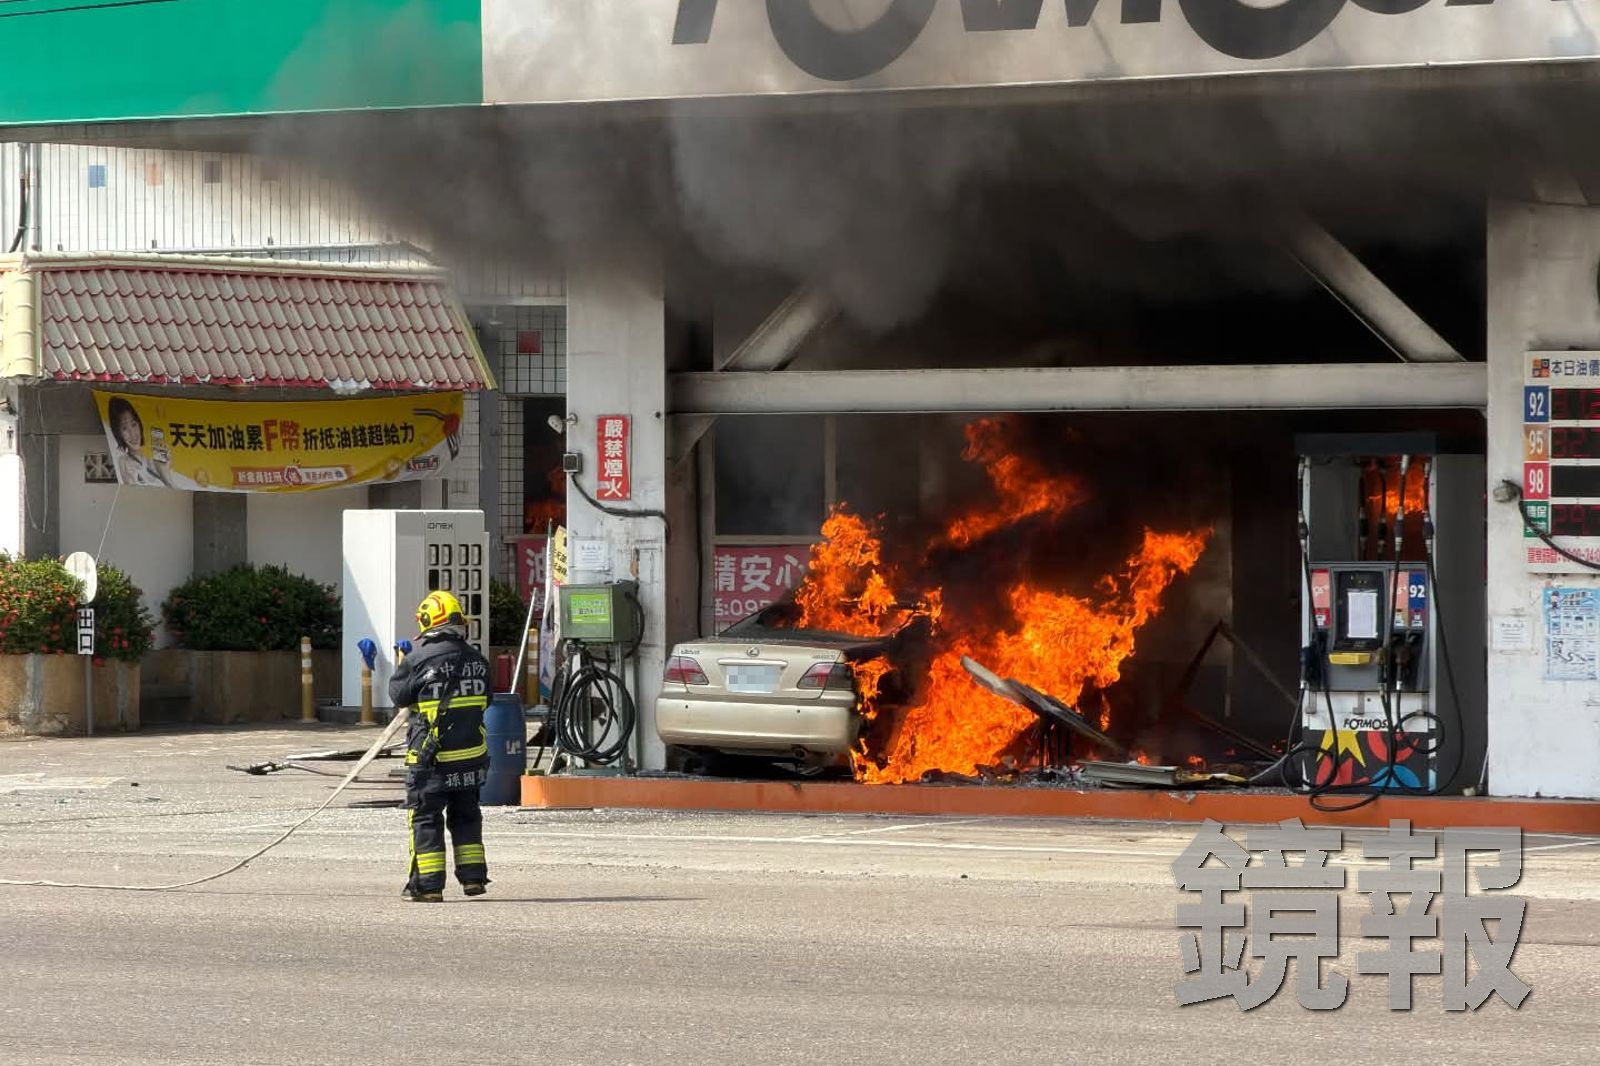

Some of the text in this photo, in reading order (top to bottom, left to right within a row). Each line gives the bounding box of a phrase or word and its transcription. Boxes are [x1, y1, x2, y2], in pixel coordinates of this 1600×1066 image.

[1551, 360, 1600, 376] 本日油價
[1529, 391, 1544, 416] 92
[1529, 430, 1544, 455] 95
[604, 419, 624, 497] 嚴禁煙火
[1529, 469, 1544, 493] 98
[1410, 585, 1425, 598] 92
[79, 610, 92, 652] 出口
[428, 679, 486, 699] TFD
[1344, 718, 1389, 730] FORMOS
